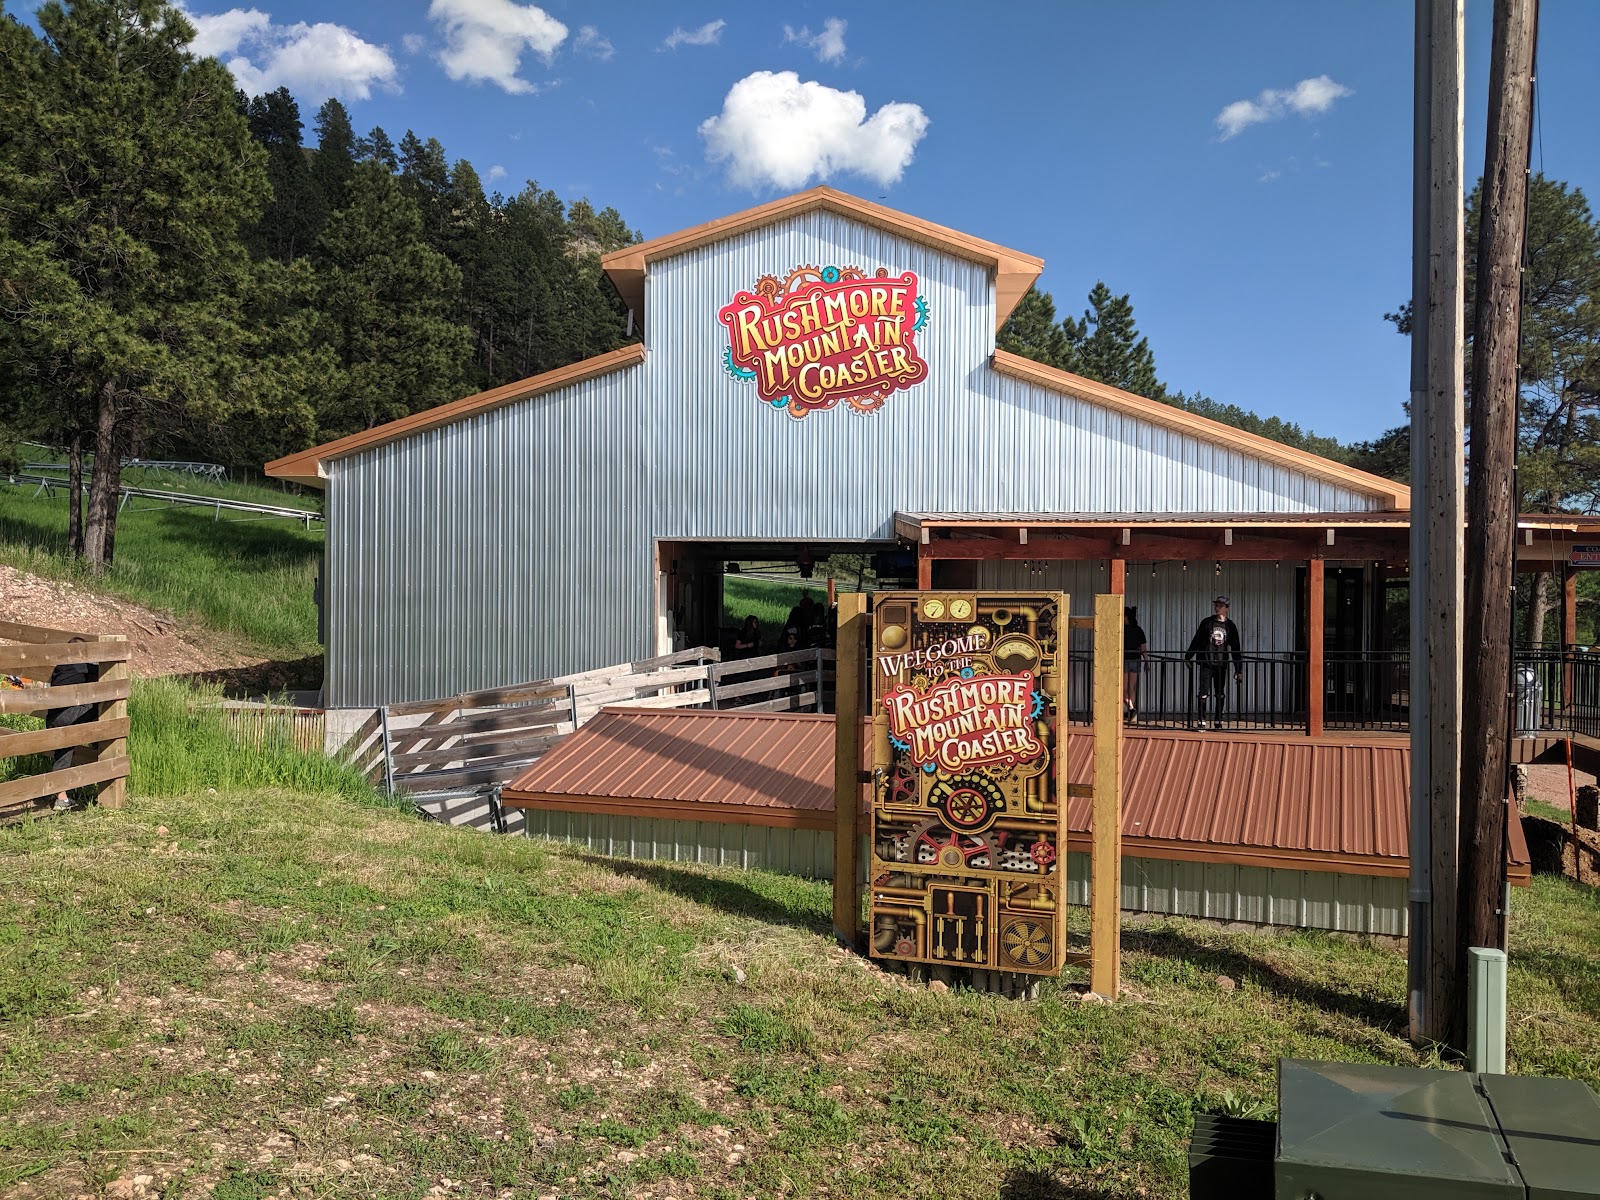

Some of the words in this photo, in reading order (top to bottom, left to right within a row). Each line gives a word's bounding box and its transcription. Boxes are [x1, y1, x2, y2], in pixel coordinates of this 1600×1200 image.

[737, 288, 907, 355] RUSHMORE
[763, 316, 905, 389] MOUNTAIN
[799, 347, 916, 398] COASTER
[879, 634, 987, 677] WELCOME
[924, 665, 944, 678] TO
[949, 657, 973, 671] THE
[895, 681, 1027, 732] RUSHMORE
[915, 704, 1026, 759] MOUNTAIN
[941, 728, 1035, 767] COASTER
